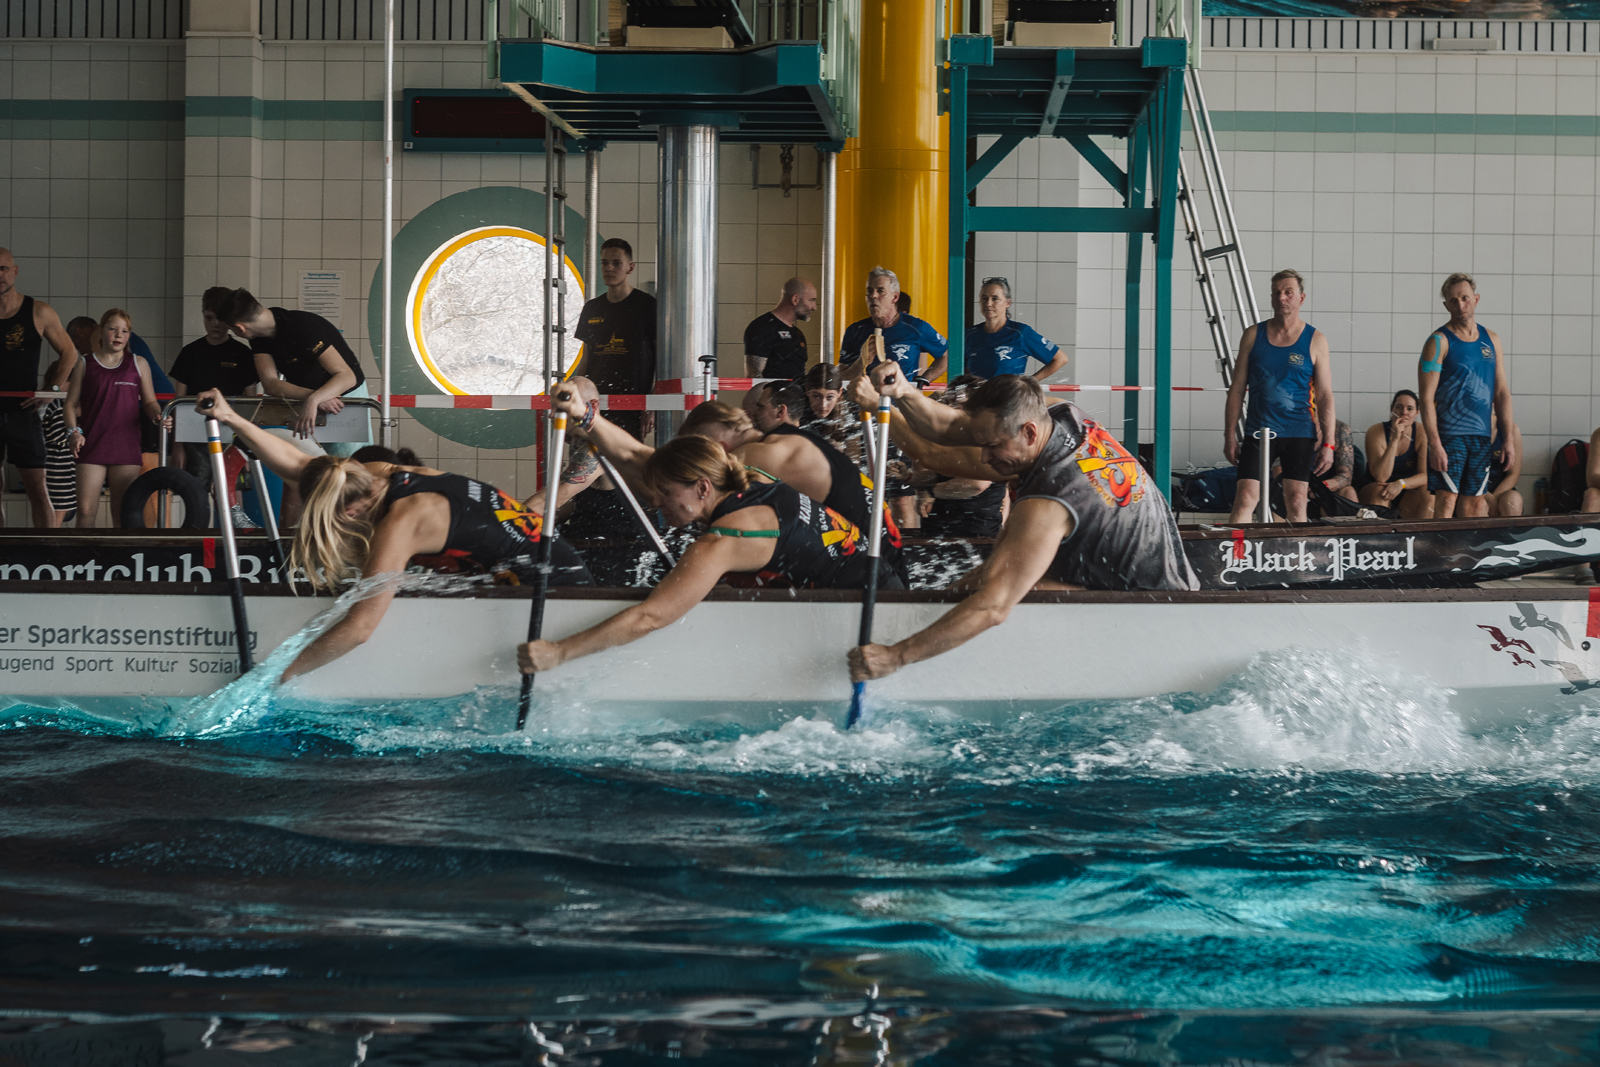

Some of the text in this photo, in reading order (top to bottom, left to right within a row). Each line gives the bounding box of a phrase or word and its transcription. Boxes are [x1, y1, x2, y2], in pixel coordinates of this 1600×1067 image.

[1219, 535, 1418, 585] Black Pearl
[66, 656, 114, 674] Sport
[125, 656, 179, 673] Kultur
[189, 658, 256, 675] Sozial
